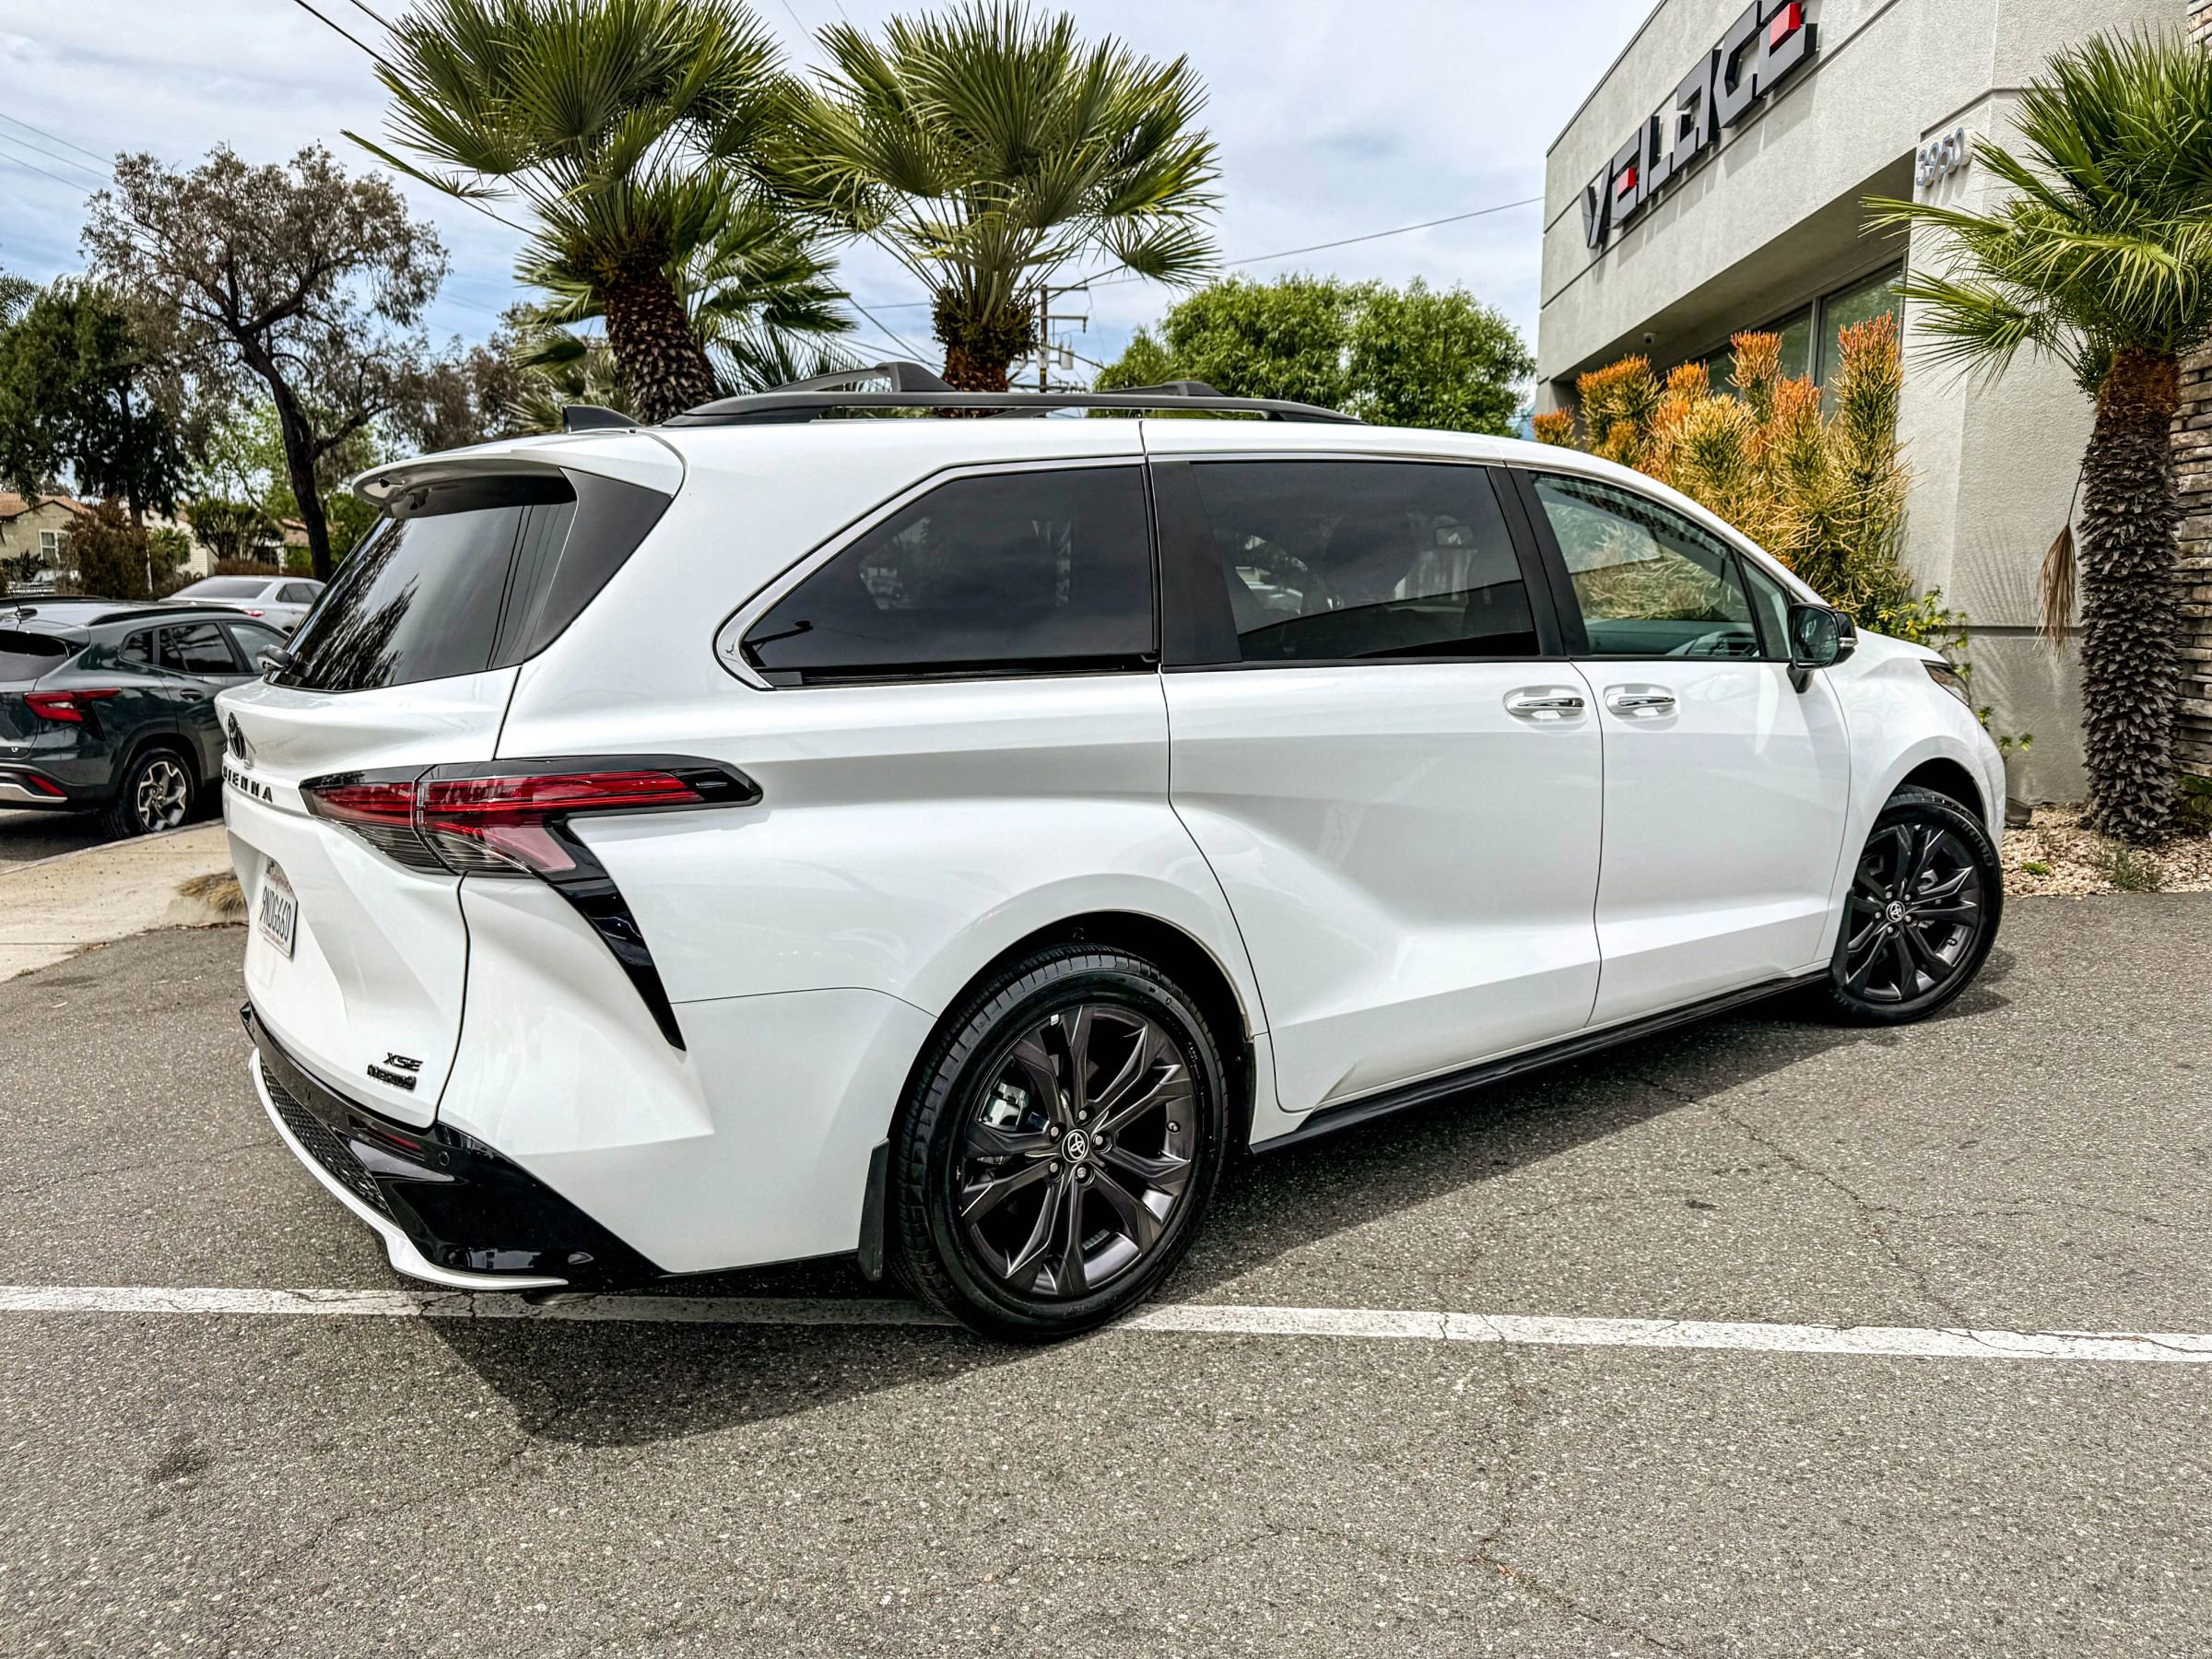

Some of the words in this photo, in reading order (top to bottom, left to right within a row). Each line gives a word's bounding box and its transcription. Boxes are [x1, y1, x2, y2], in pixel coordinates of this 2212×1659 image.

[1916, 127, 1966, 186] 3950
[222, 765, 273, 803] SIENNA
[382, 1052, 424, 1072] XSE
